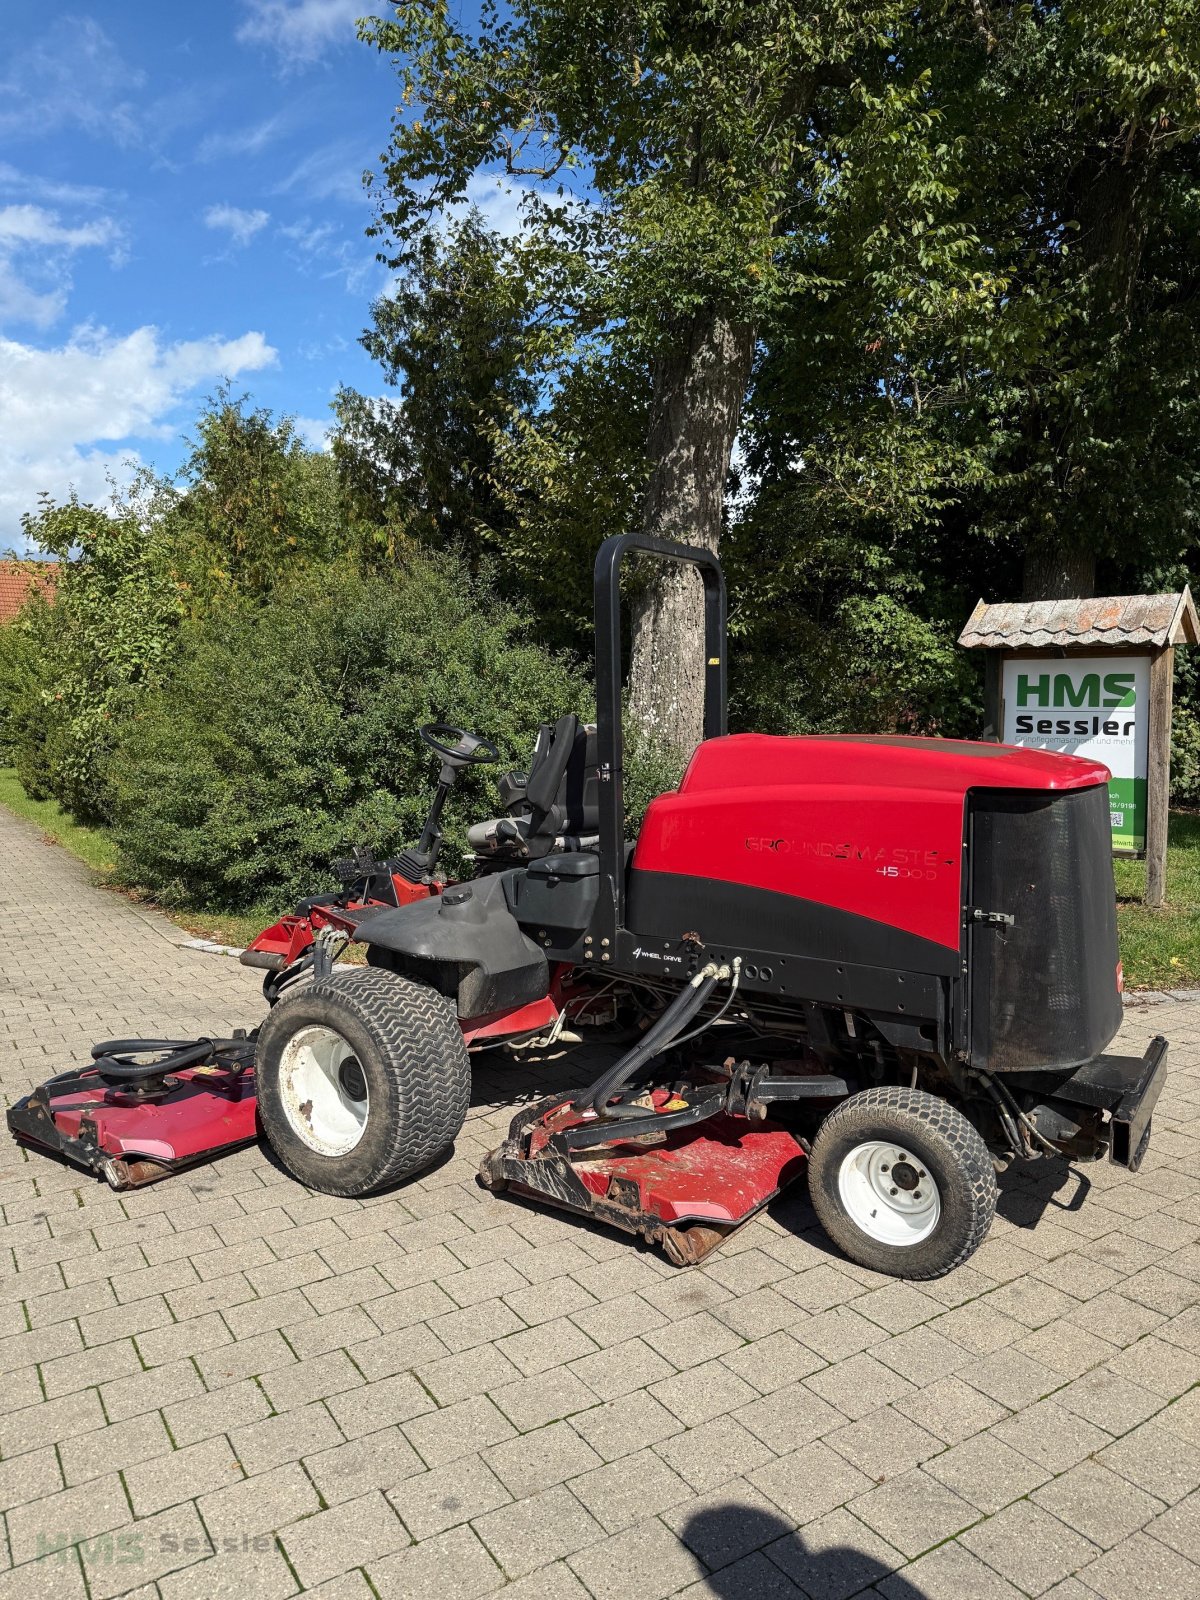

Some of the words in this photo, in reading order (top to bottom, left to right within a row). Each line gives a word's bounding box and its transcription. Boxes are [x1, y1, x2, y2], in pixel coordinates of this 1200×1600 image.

[1016, 673, 1136, 708] HMS
[1015, 715, 1136, 736] Sessler
[1096, 736, 1111, 745] und
[1113, 737, 1136, 745] mehr
[745, 837, 954, 866] GROUNDSMASTE
[632, 947, 642, 959] 4
[642, 951, 661, 960] WHEEL
[664, 954, 682, 963] DRIVE
